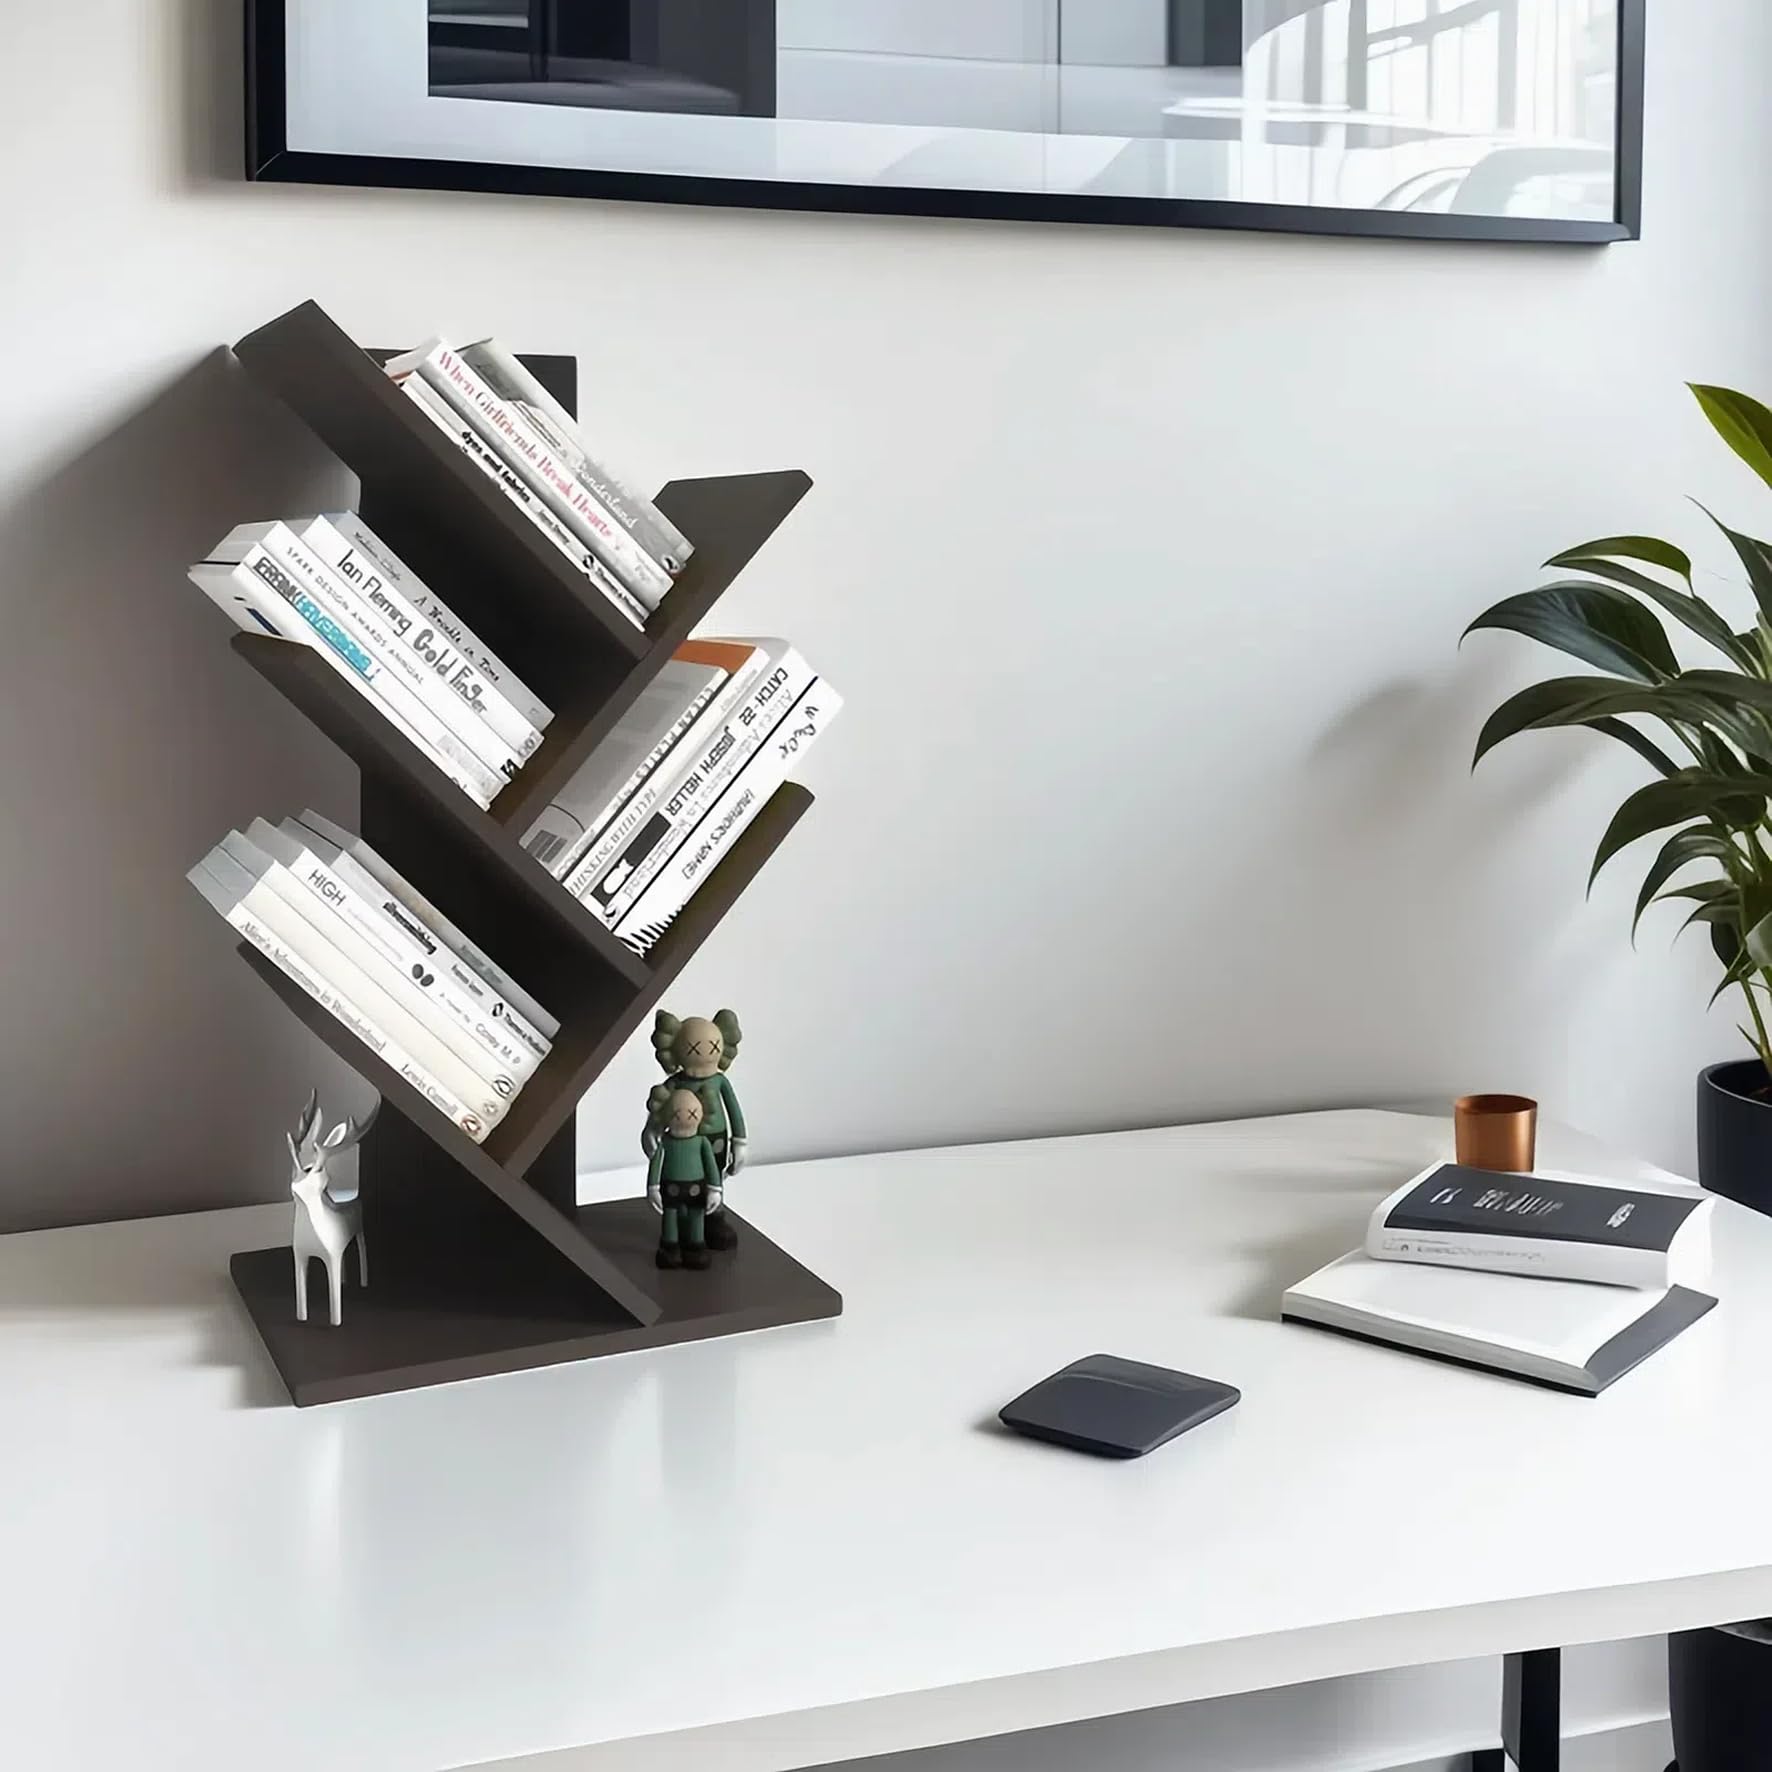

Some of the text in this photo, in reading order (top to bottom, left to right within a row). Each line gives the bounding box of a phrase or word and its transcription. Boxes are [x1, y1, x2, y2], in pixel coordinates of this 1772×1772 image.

[437, 352, 478, 393] When
[473, 391, 541, 459] Girlfriends
[537, 458, 575, 495] Break
[573, 494, 615, 536] Hearts
[482, 452, 502, 471] and
[287, 548, 313, 573] SPARK
[316, 576, 349, 609] DESIGN
[351, 611, 385, 645] AWARDS
[414, 593, 427, 606] A
[337, 550, 369, 582] Ian
[356, 577, 415, 635] Fleming
[411, 628, 458, 675] Gold
[450, 666, 497, 713] Finger
[697, 727, 738, 772] JOSEPH
[665, 773, 702, 814] HELLER
[308, 870, 345, 904] HIGH
